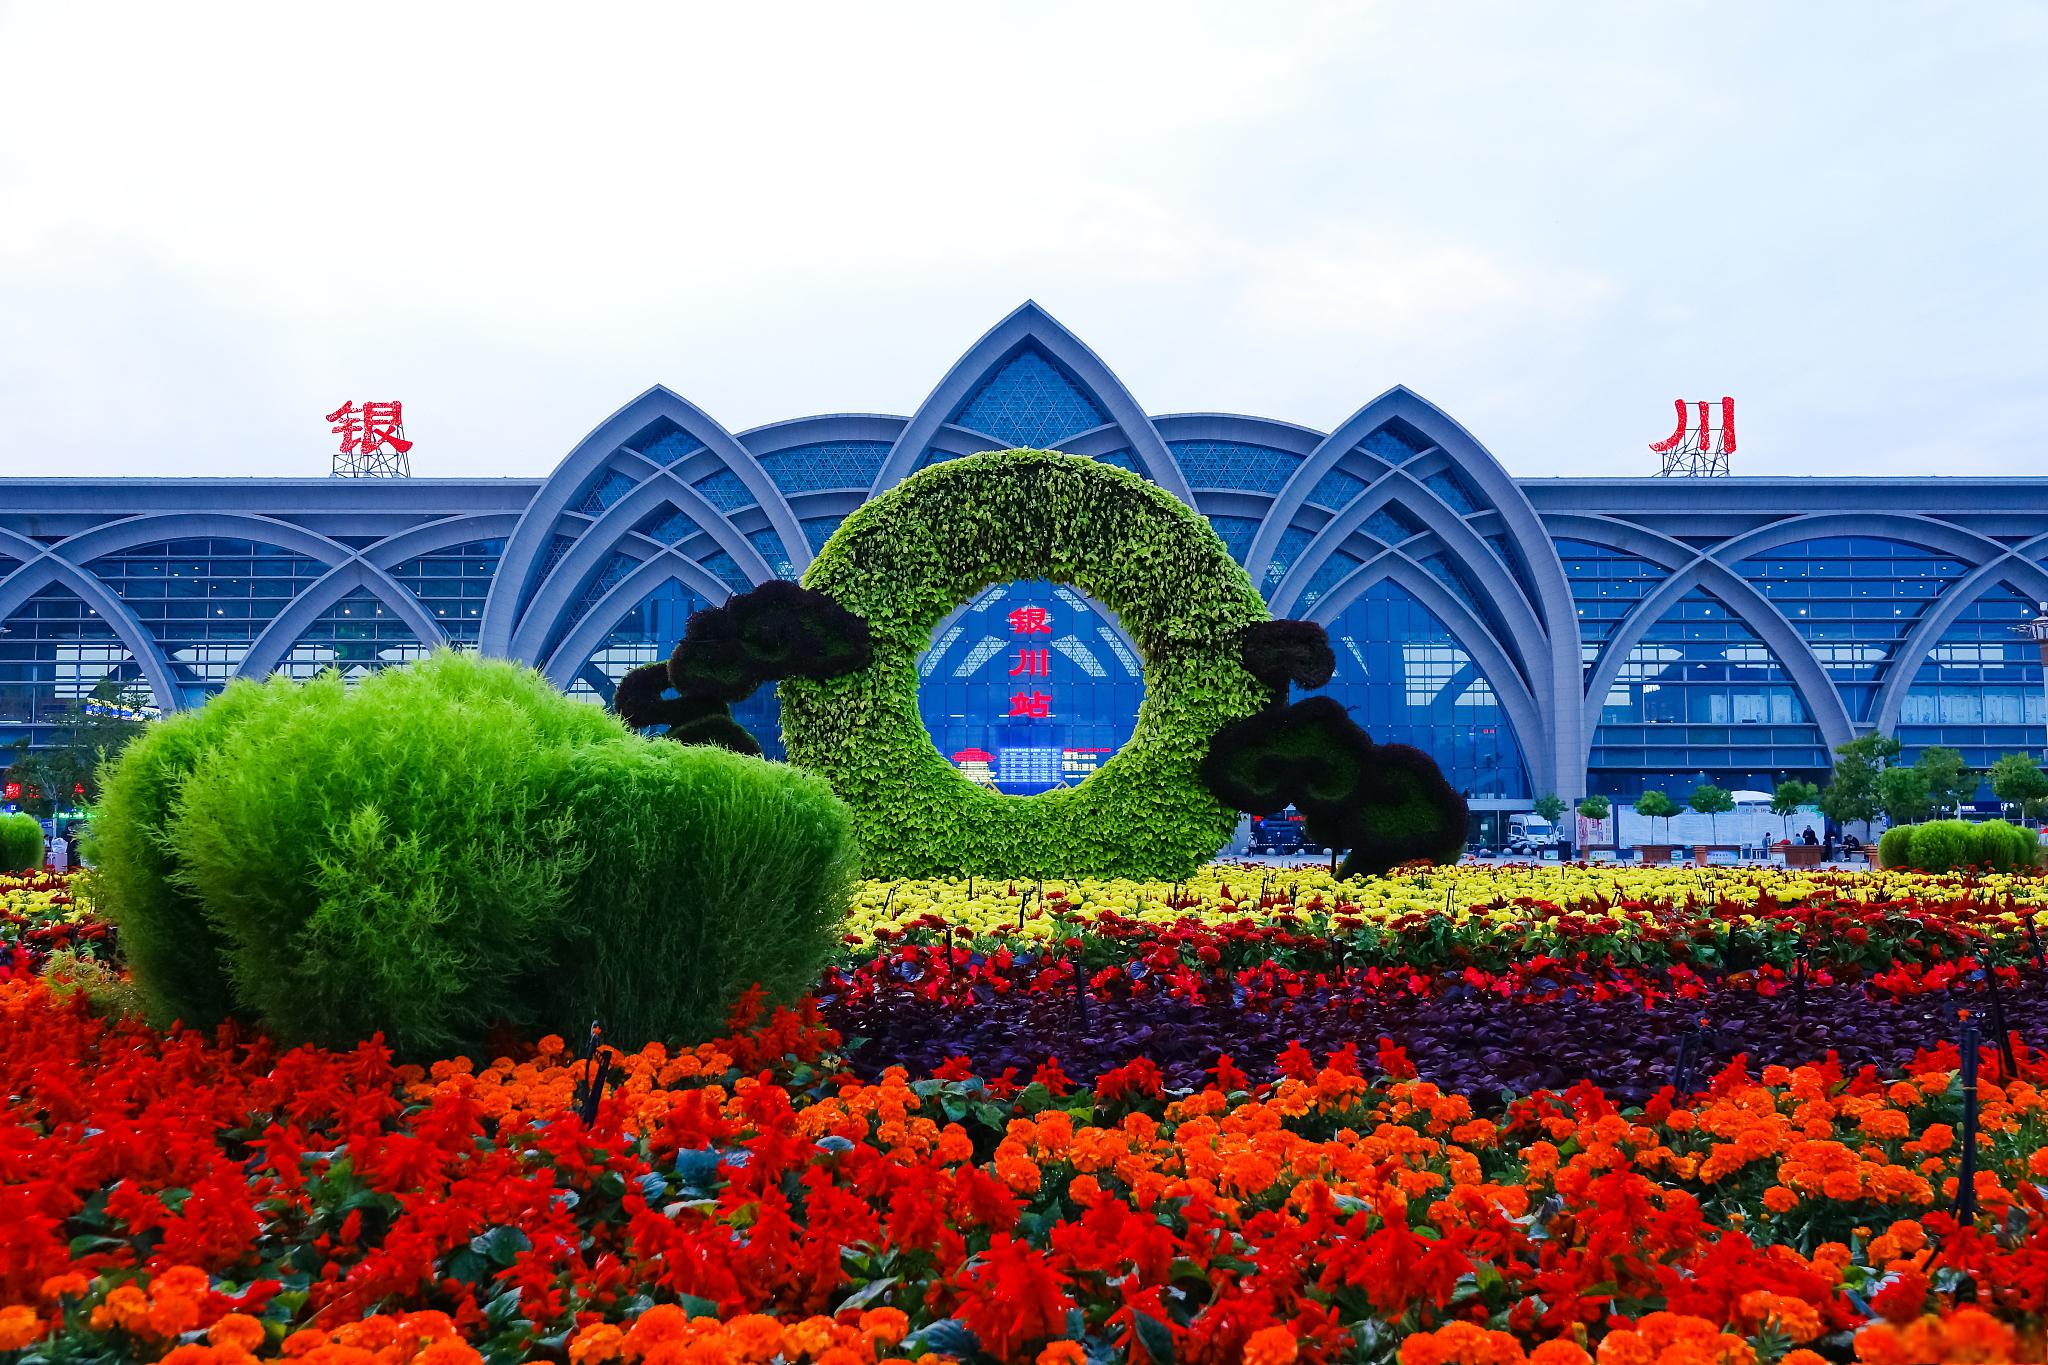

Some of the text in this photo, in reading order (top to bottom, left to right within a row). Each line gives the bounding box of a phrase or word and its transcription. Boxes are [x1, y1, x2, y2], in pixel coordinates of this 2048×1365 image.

[325, 399, 414, 455] 银
[1649, 396, 1736, 454] 川
[1008, 607, 1053, 718] 银川站
